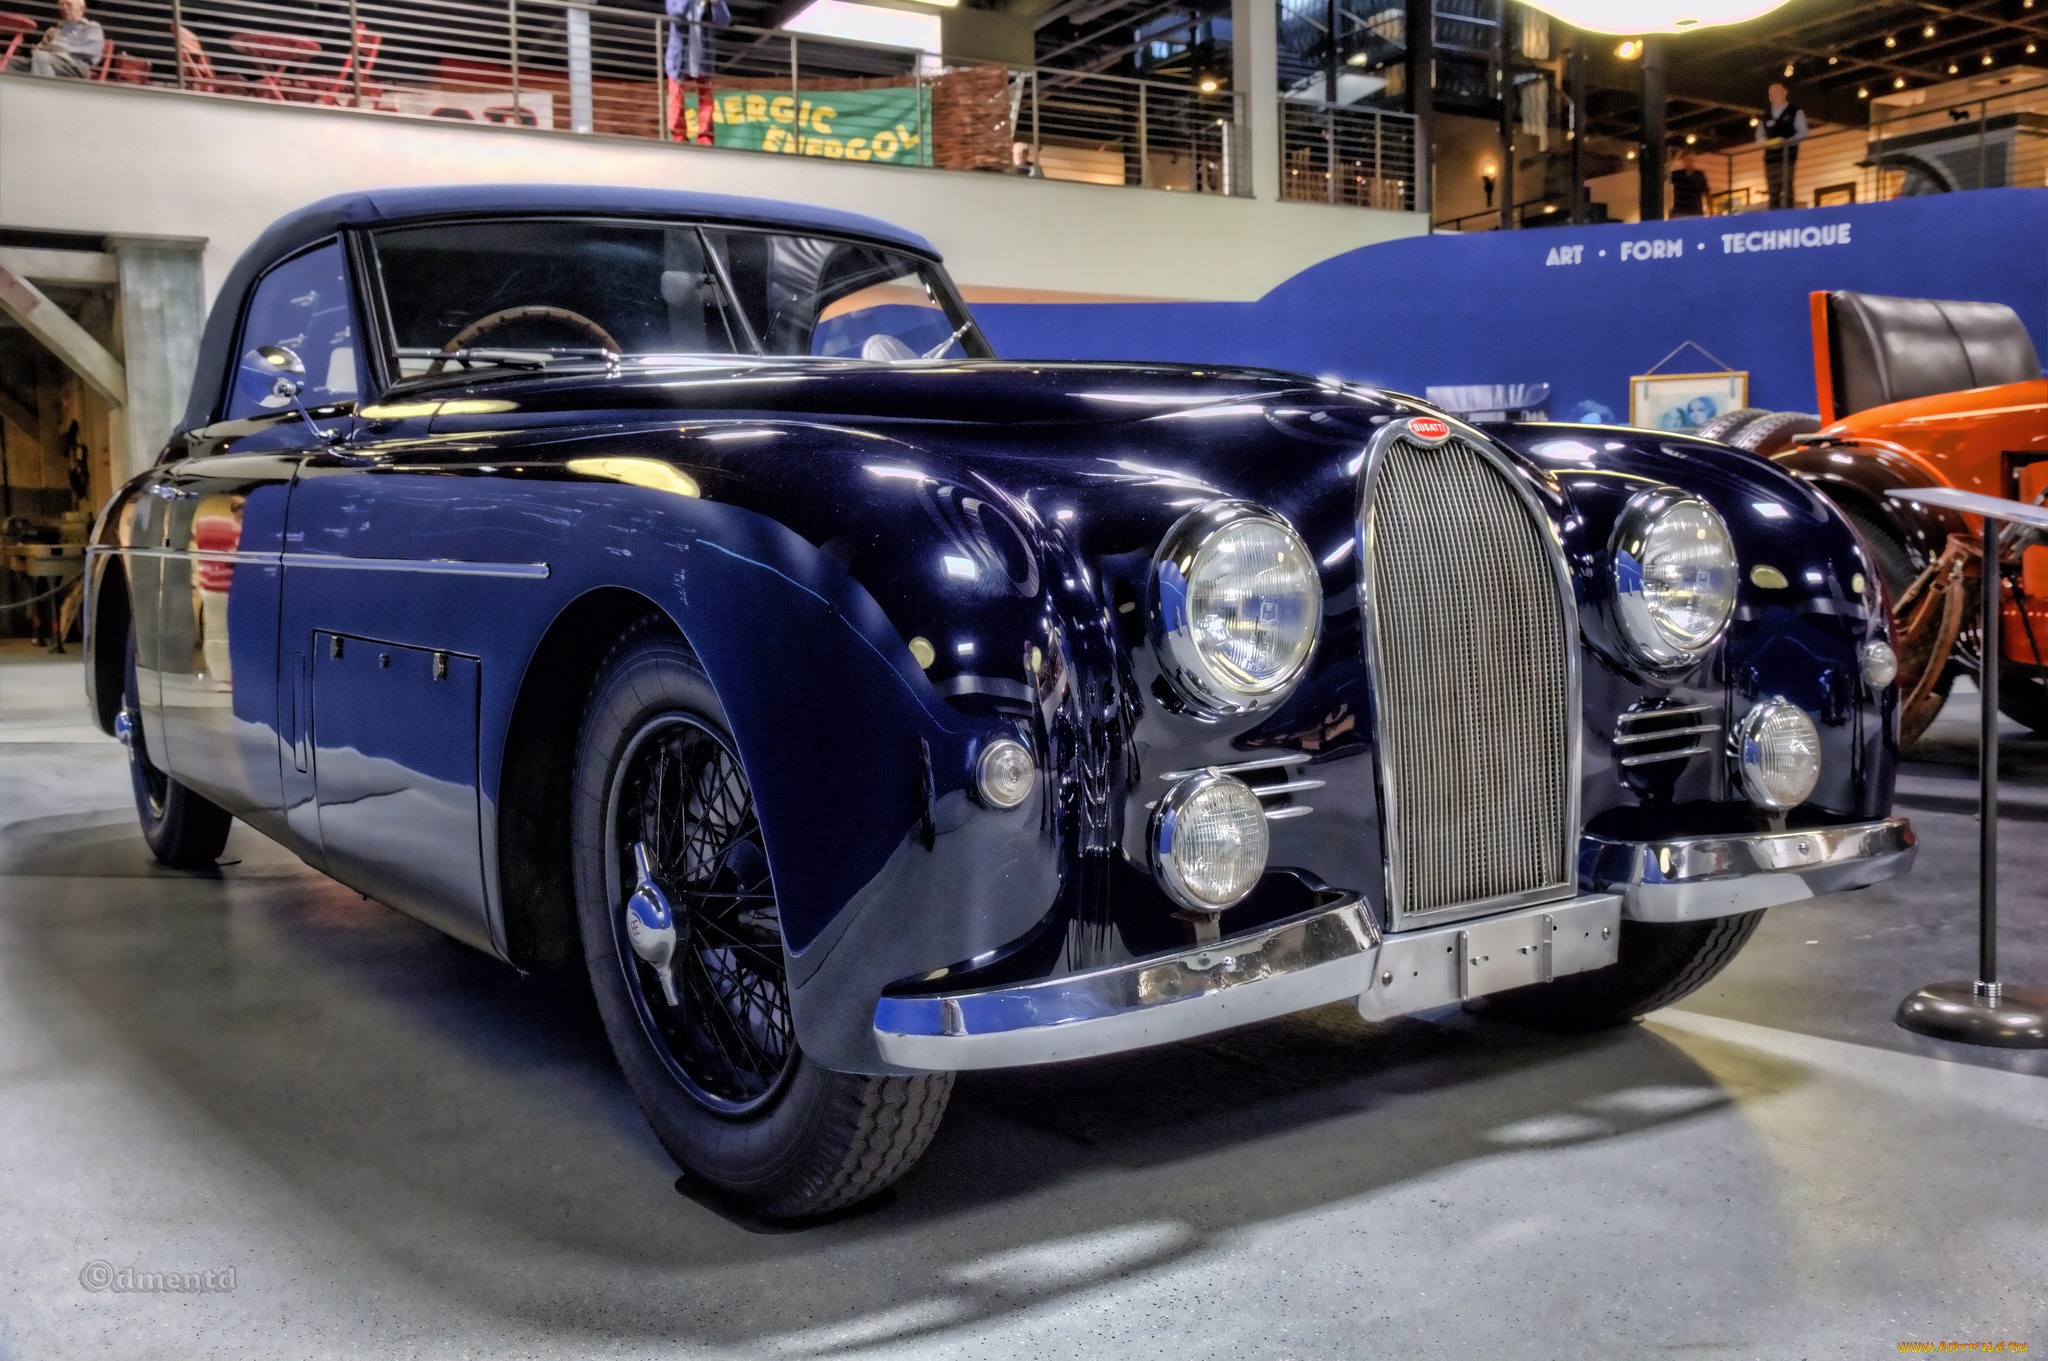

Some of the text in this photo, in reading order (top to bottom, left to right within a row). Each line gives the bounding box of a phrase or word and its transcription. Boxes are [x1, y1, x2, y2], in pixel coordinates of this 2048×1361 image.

[1546, 223, 1852, 266] ART FORM TECHNIQUE
[1412, 422, 1447, 433] BUGATTI
